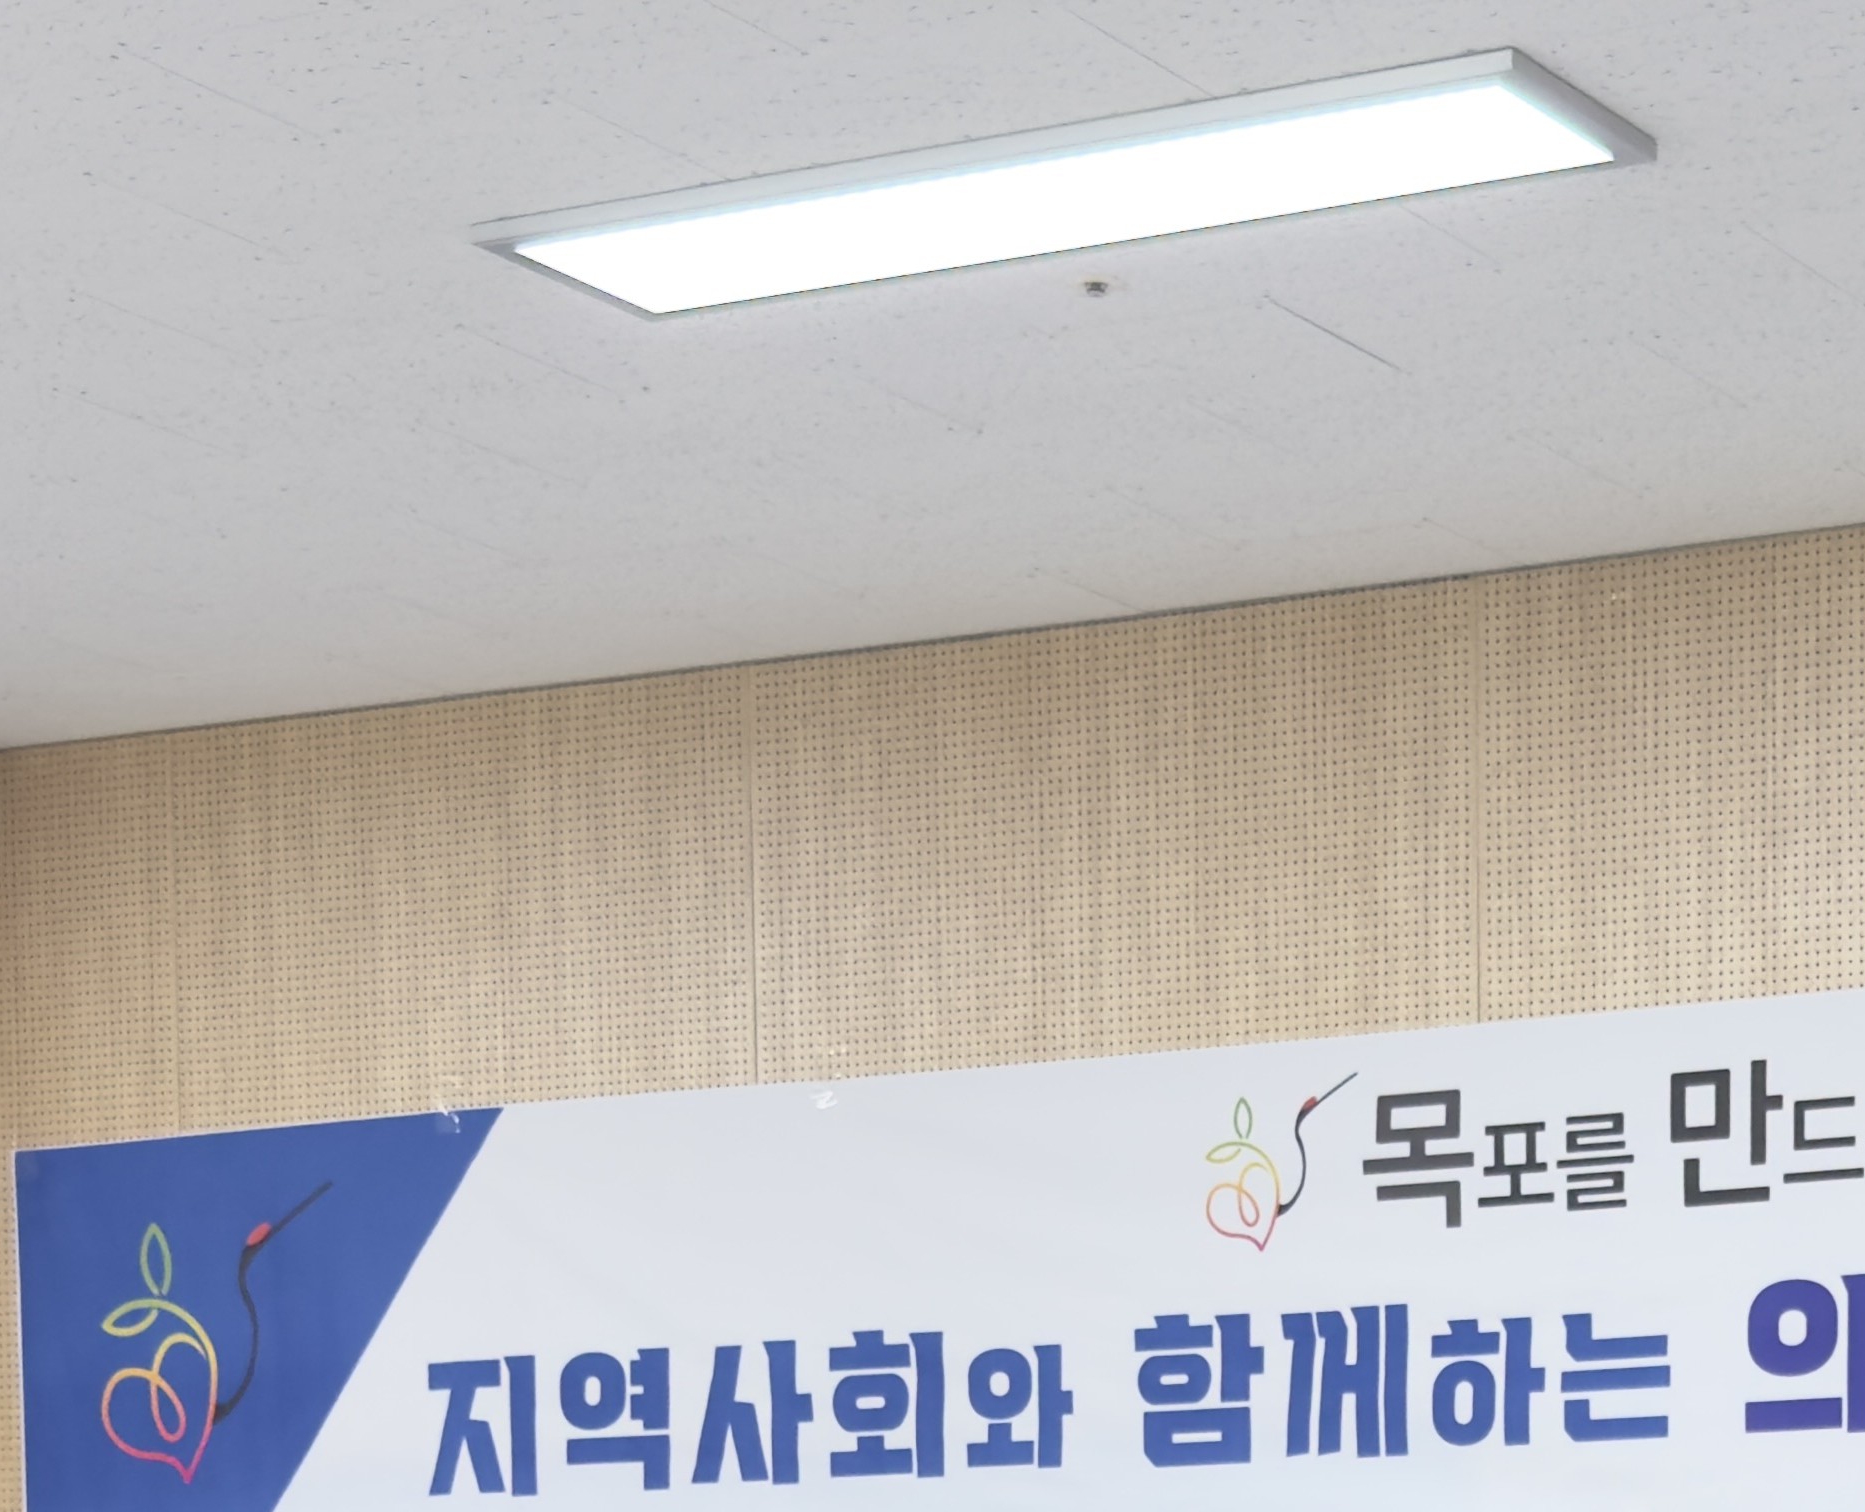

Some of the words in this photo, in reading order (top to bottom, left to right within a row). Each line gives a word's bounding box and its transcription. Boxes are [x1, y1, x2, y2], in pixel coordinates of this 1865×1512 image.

[1363, 1089, 1634, 1228] 목포를
[428, 1330, 1073, 1496] 지역사회와
[1134, 1304, 1671, 1467] 함께하는
